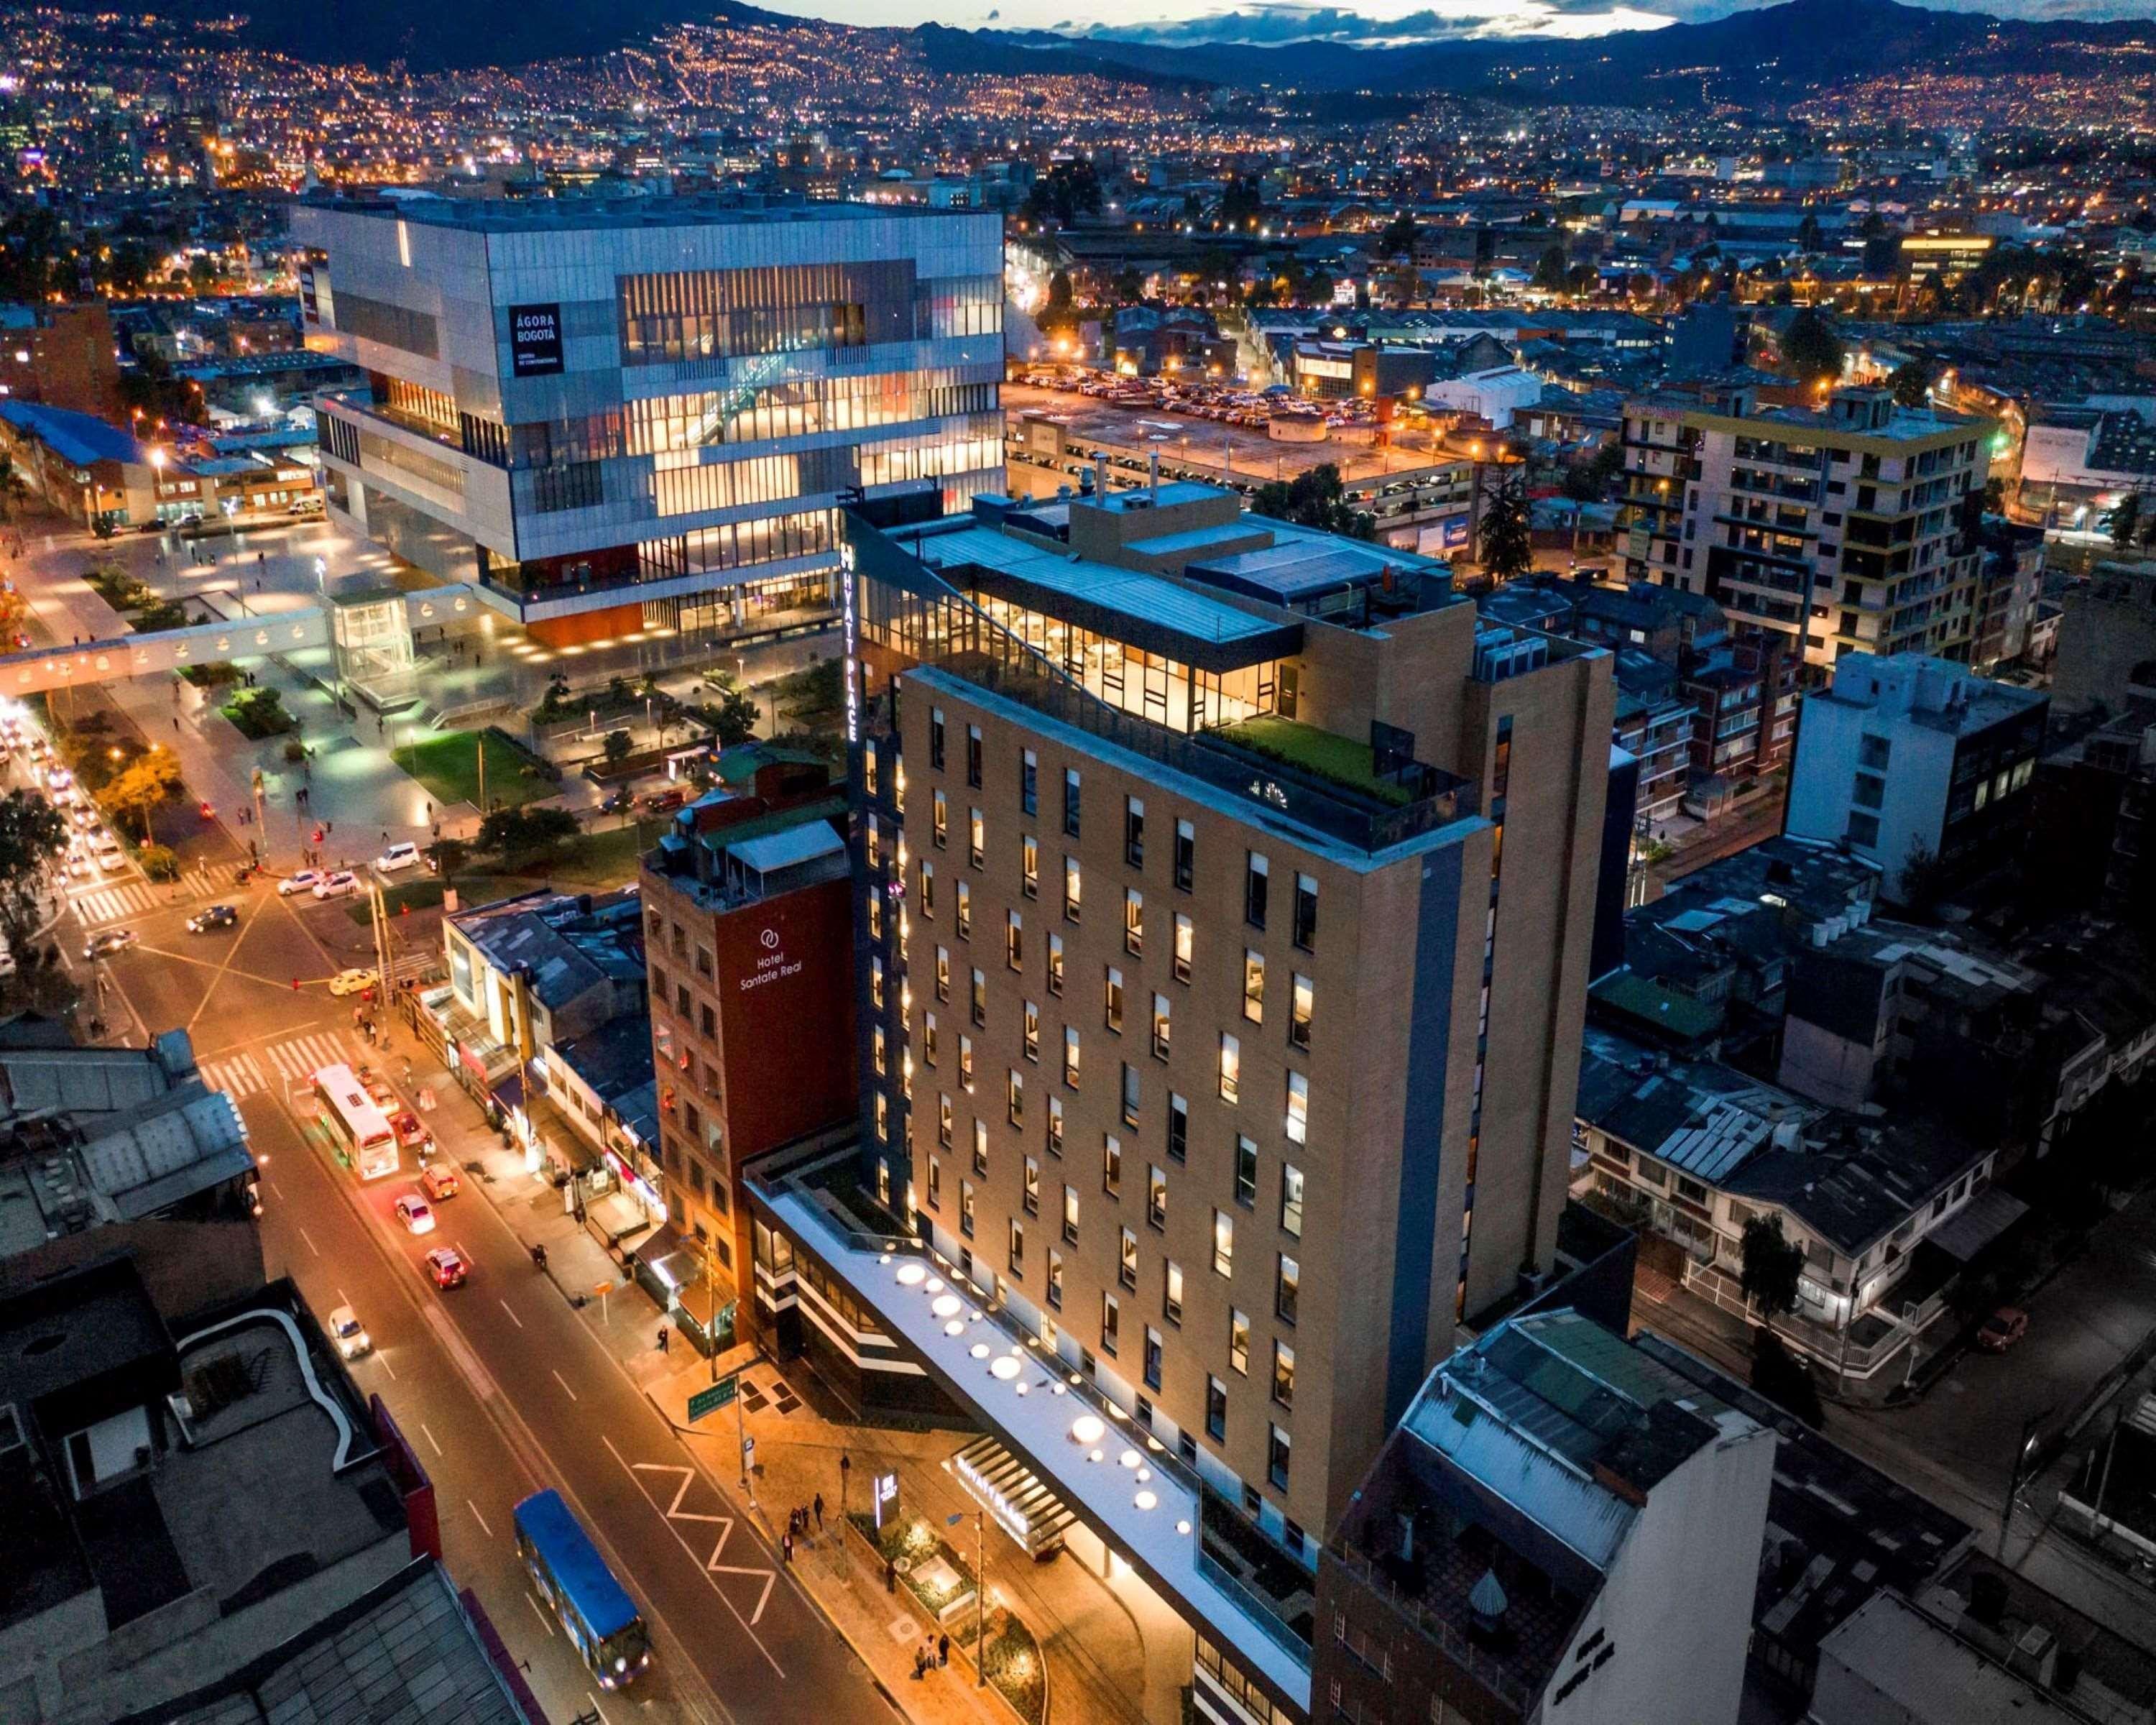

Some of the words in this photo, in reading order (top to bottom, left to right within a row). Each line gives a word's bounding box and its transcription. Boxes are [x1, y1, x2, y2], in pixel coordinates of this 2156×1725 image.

[517, 326, 556, 342] BOGOTÁ
[843, 572, 853, 654] HYATT
[847, 659, 857, 742] PLACE
[740, 970, 778, 990] Santafe
[780, 960, 801, 977] Real
[757, 951, 784, 970] Hotel
